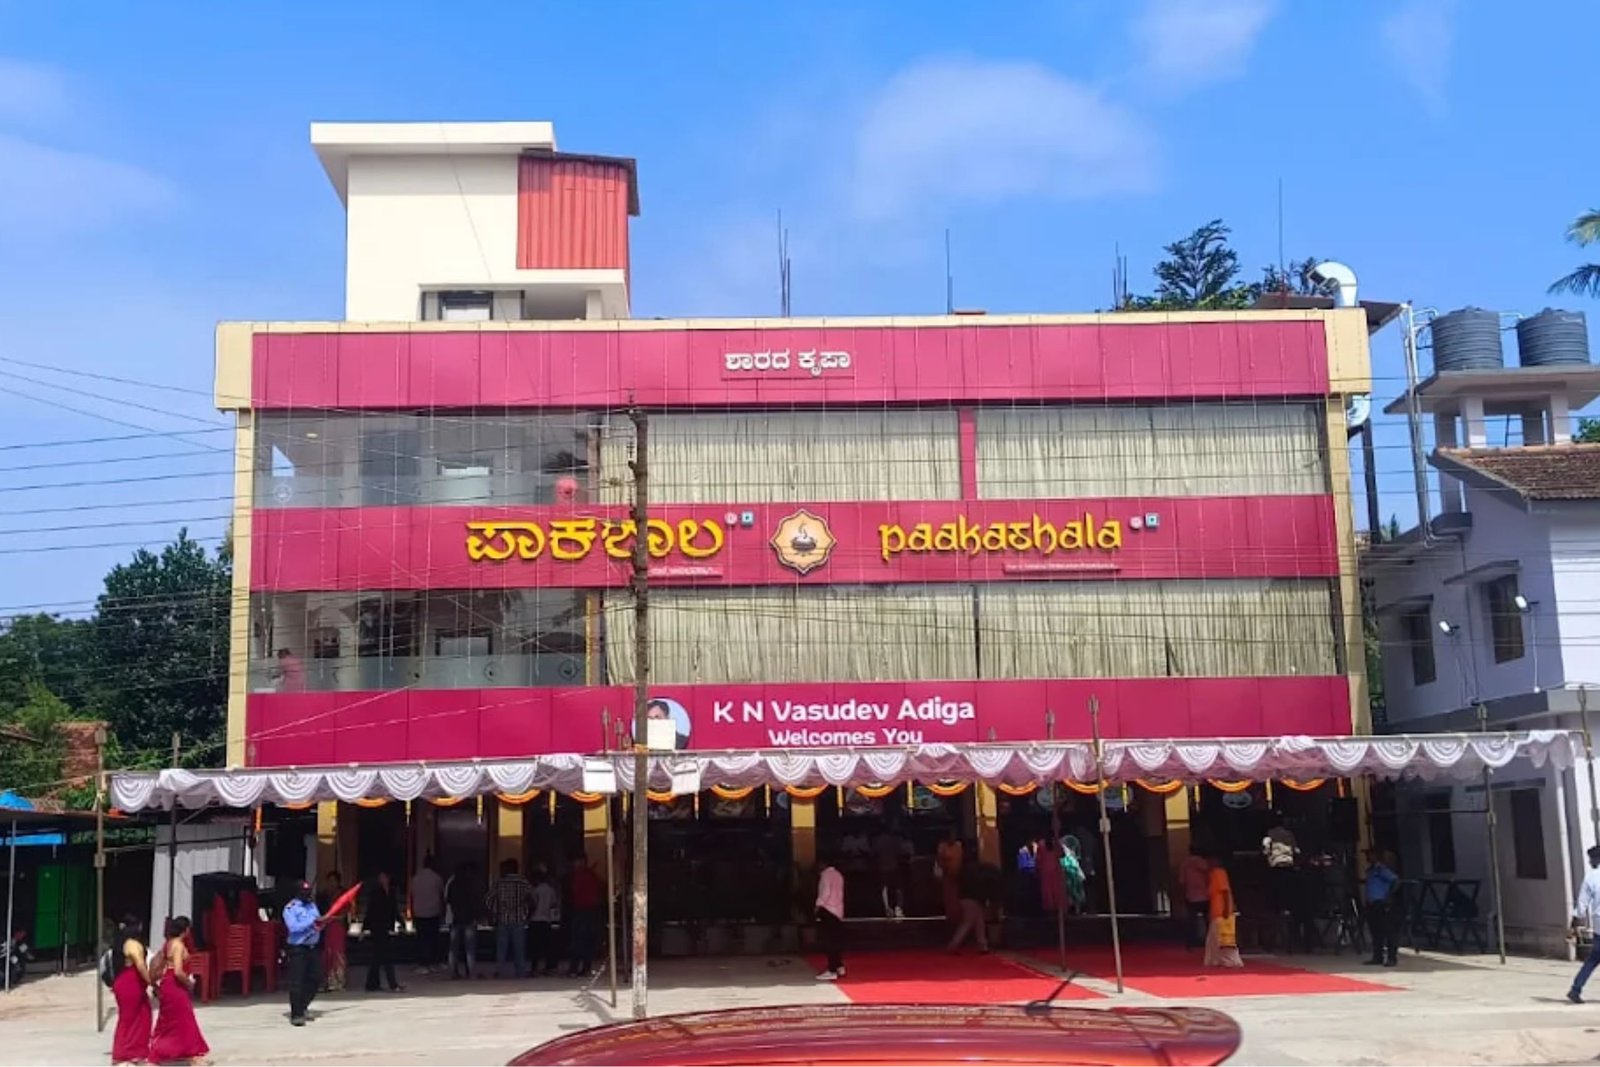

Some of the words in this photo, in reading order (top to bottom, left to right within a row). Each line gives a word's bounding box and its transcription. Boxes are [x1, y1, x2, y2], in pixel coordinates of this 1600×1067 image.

[879, 512, 1123, 561] paakashala
[713, 701, 732, 722] K
[743, 701, 763, 722] N
[771, 699, 889, 722] Vasudev
[897, 697, 975, 725] Adiga
[768, 728, 876, 747] Welcomes
[883, 728, 923, 746] You
